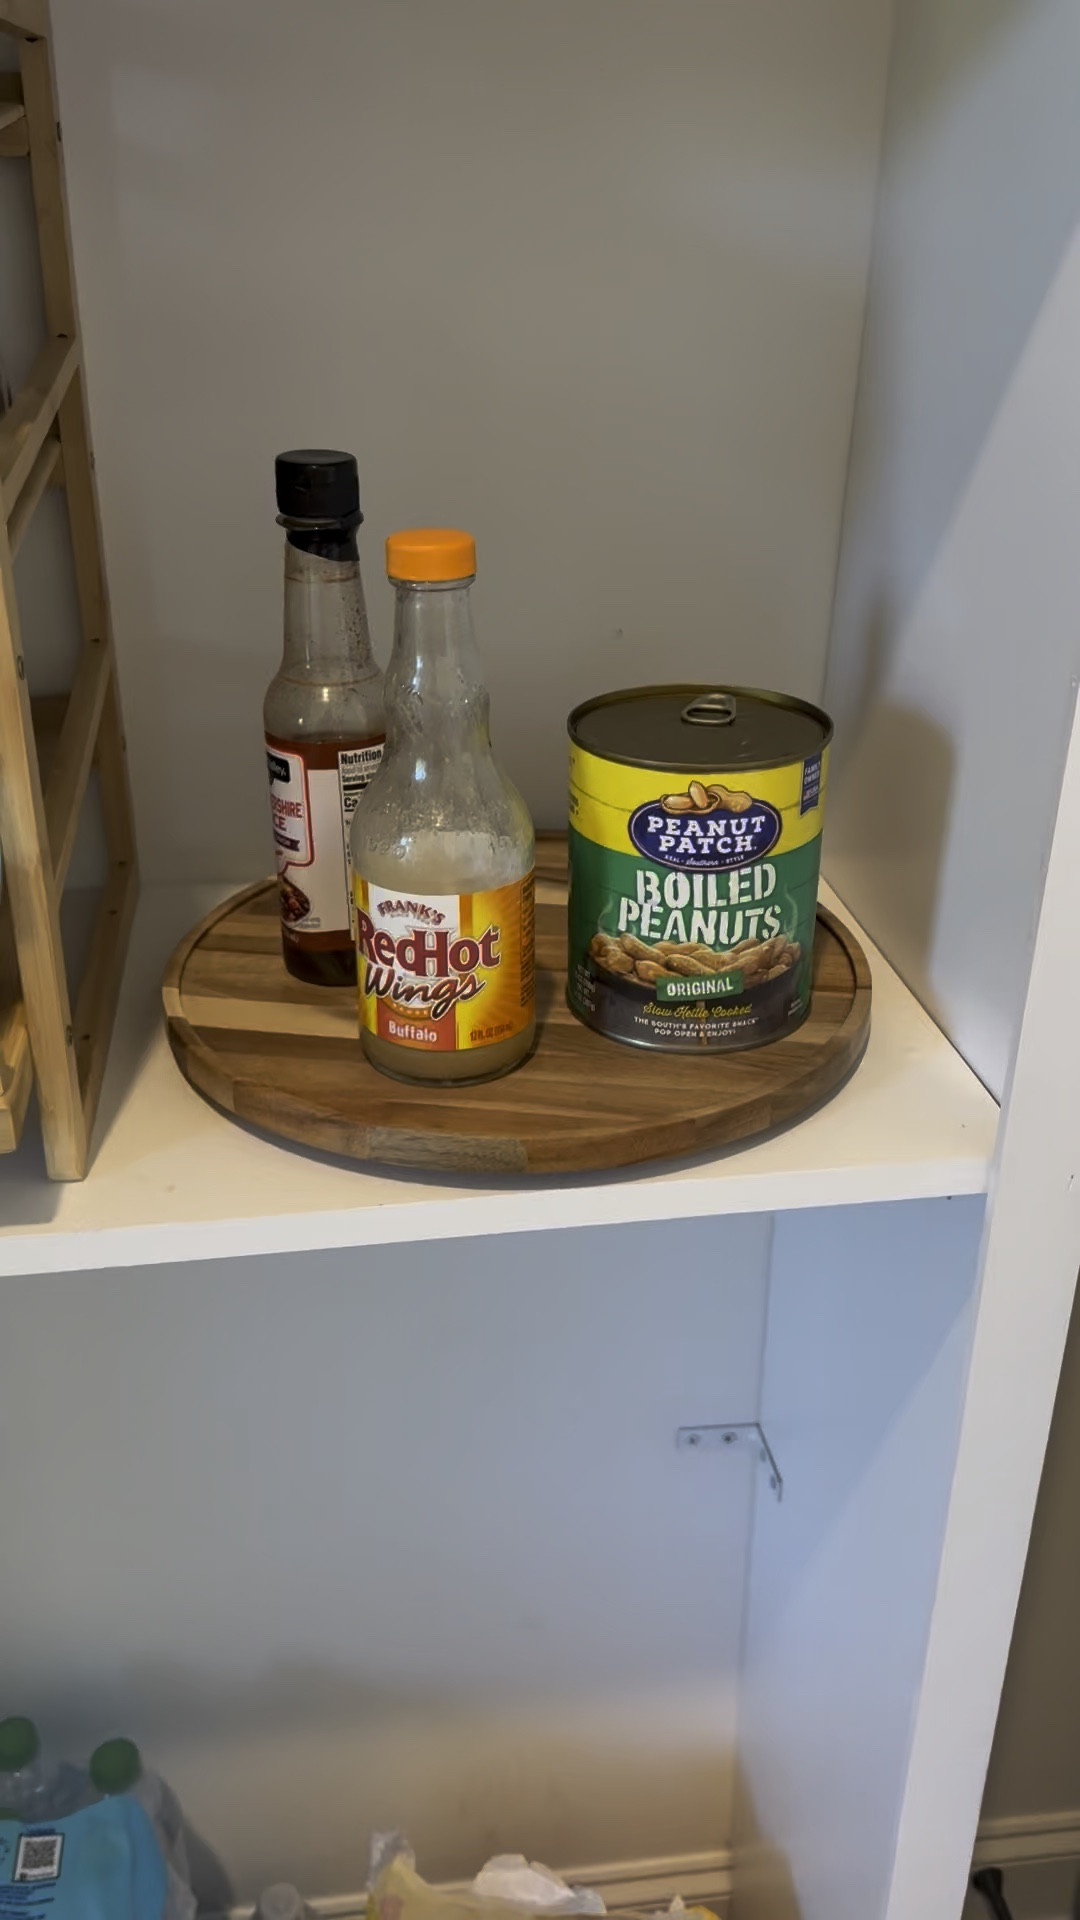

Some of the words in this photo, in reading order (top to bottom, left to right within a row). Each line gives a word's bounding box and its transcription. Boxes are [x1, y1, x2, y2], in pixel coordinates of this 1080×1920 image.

[341, 750, 382, 764] Nutrition
[647, 815, 766, 837] PEANUT
[658, 834, 754, 854] PATCH
[636, 863, 777, 909] BOILED
[376, 899, 447, 926] FRANK'S
[617, 897, 782, 945] PEANUTS
[357, 908, 501, 978] RedHot
[364, 963, 487, 1021] Wings
[666, 977, 734, 997] ORIGINAL
[643, 1002, 672, 1017] Slow
[711, 1003, 753, 1018] Cooked
[388, 1020, 438, 1043] Buffalo
[634, 1016, 649, 1026] THE
[651, 1019, 687, 1030] SOUTH'S
[689, 1021, 730, 1031] FAVORITE
[654, 1028, 672, 1036] POP
[674, 1029, 697, 1038] OPEN
[699, 1030, 706, 1038] &
[707, 1027, 736, 1038] ENJOY!
